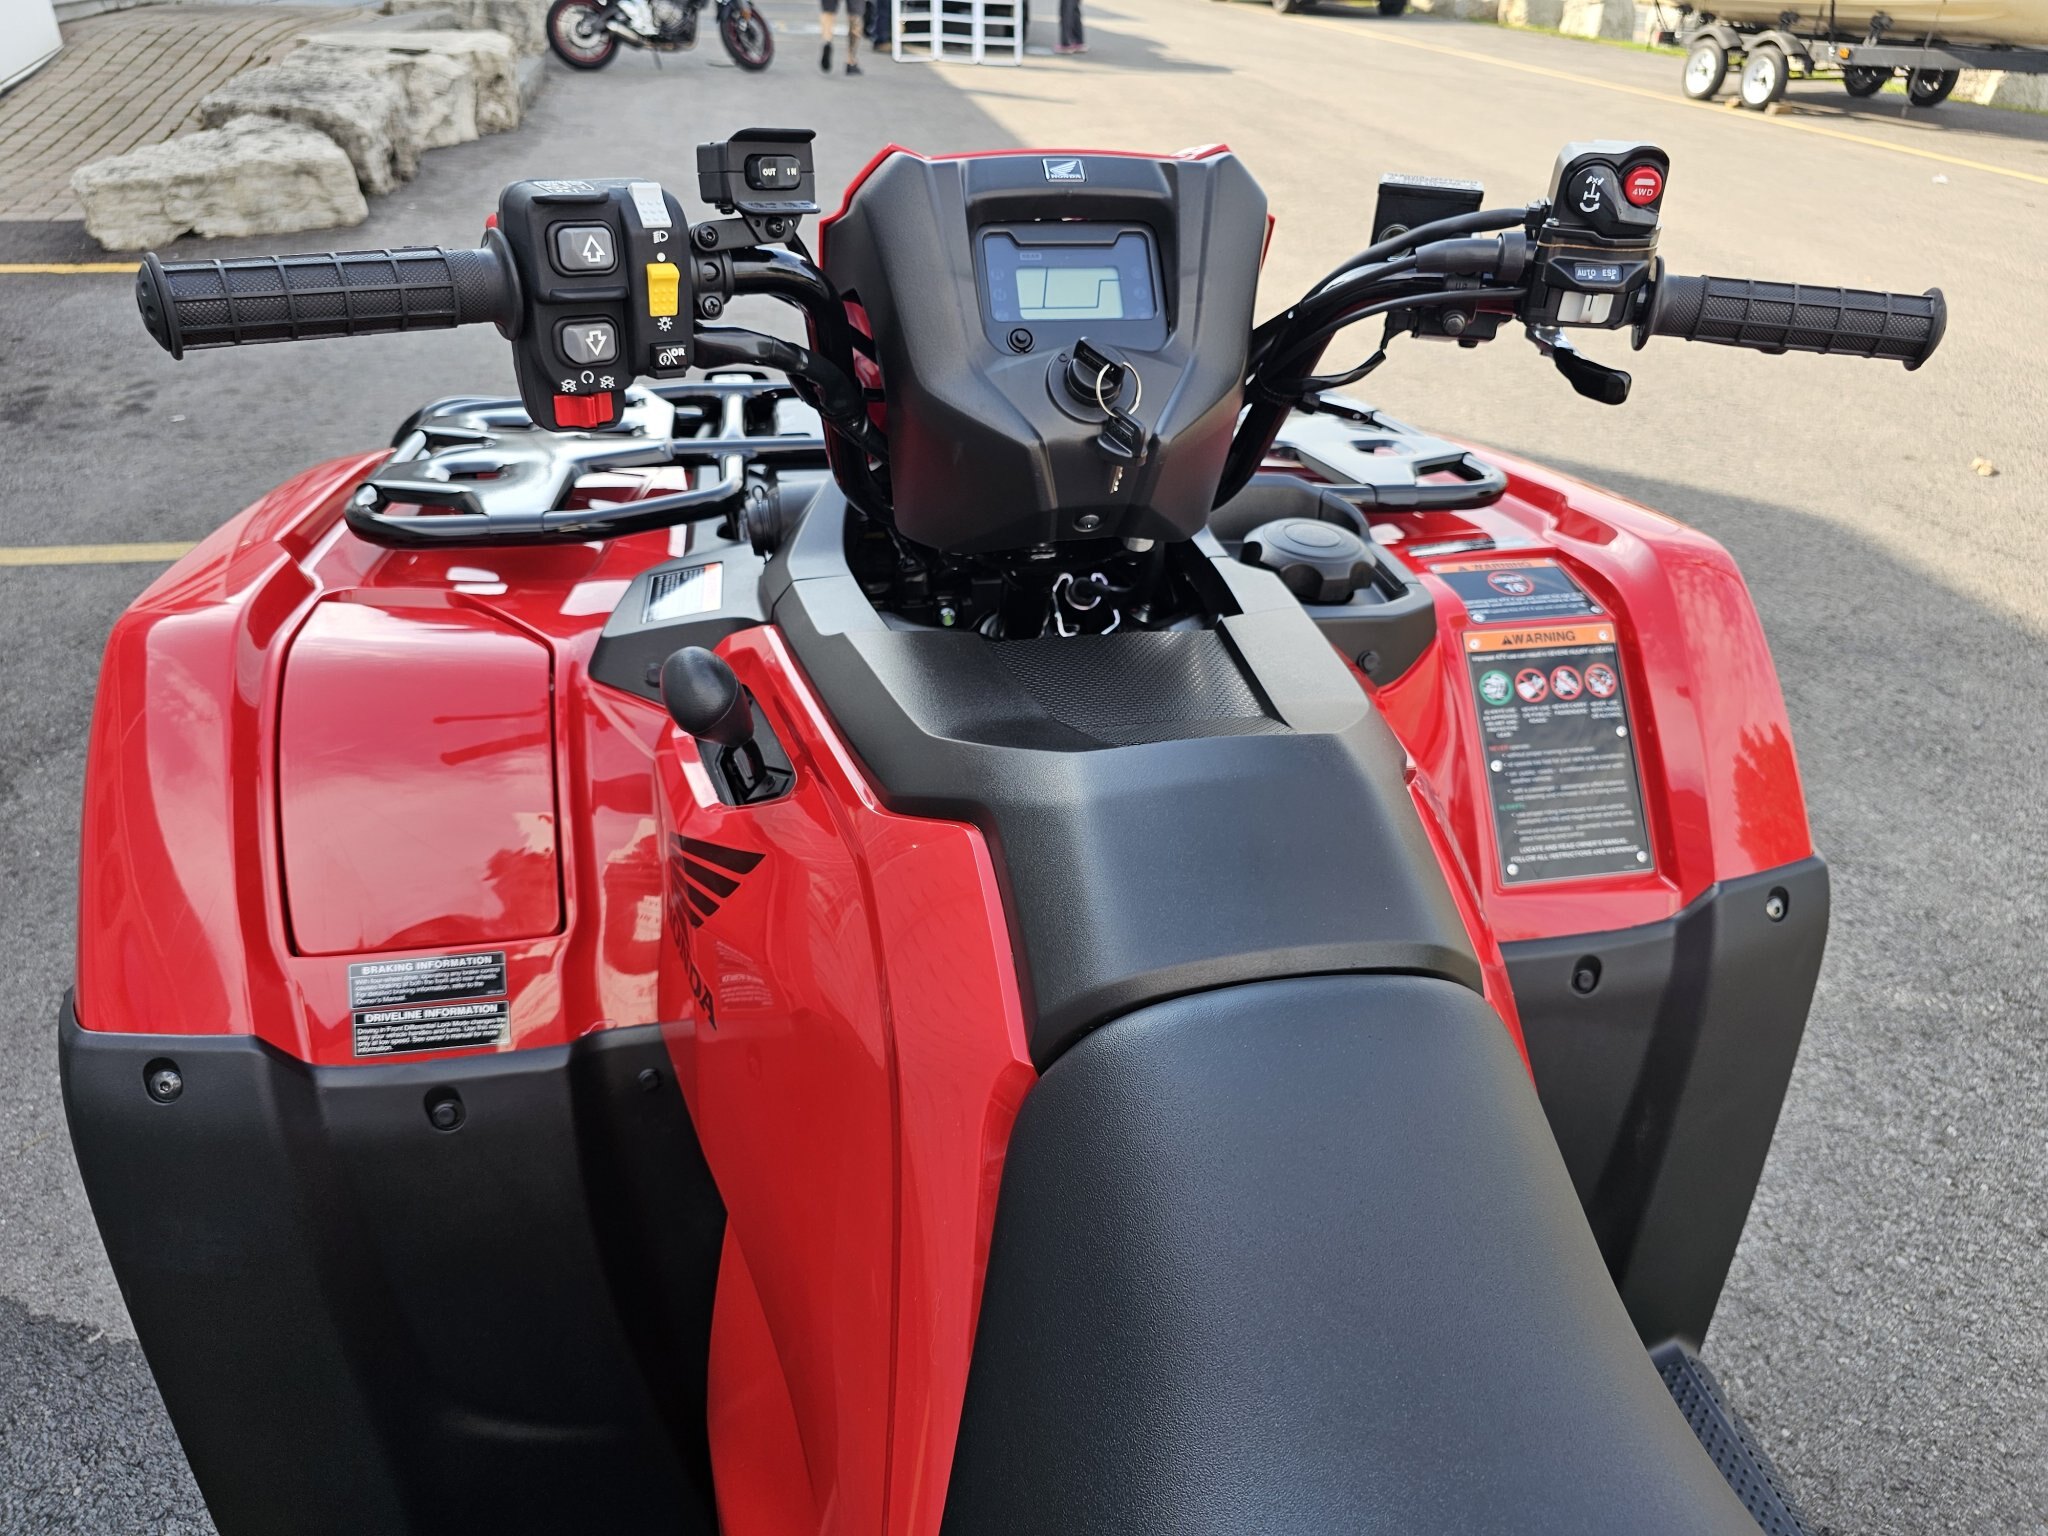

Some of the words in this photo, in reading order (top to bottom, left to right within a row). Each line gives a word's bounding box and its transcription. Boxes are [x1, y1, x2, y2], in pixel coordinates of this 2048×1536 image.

[762, 168, 776, 176] OUT
[786, 168, 796, 176] IN
[1632, 188, 1654, 196] 4WD
[1577, 268, 1596, 276] AUTO
[1602, 268, 1616, 276] ESP
[670, 348, 685, 356] OR
[1504, 582, 1527, 593] 16
[1512, 631, 1576, 644] WARNING
[361, 963, 414, 975] BRAKING
[415, 956, 492, 970] INFORMATION
[364, 1010, 422, 1023] DRIVELINE
[423, 1004, 498, 1018] INFORMATION
